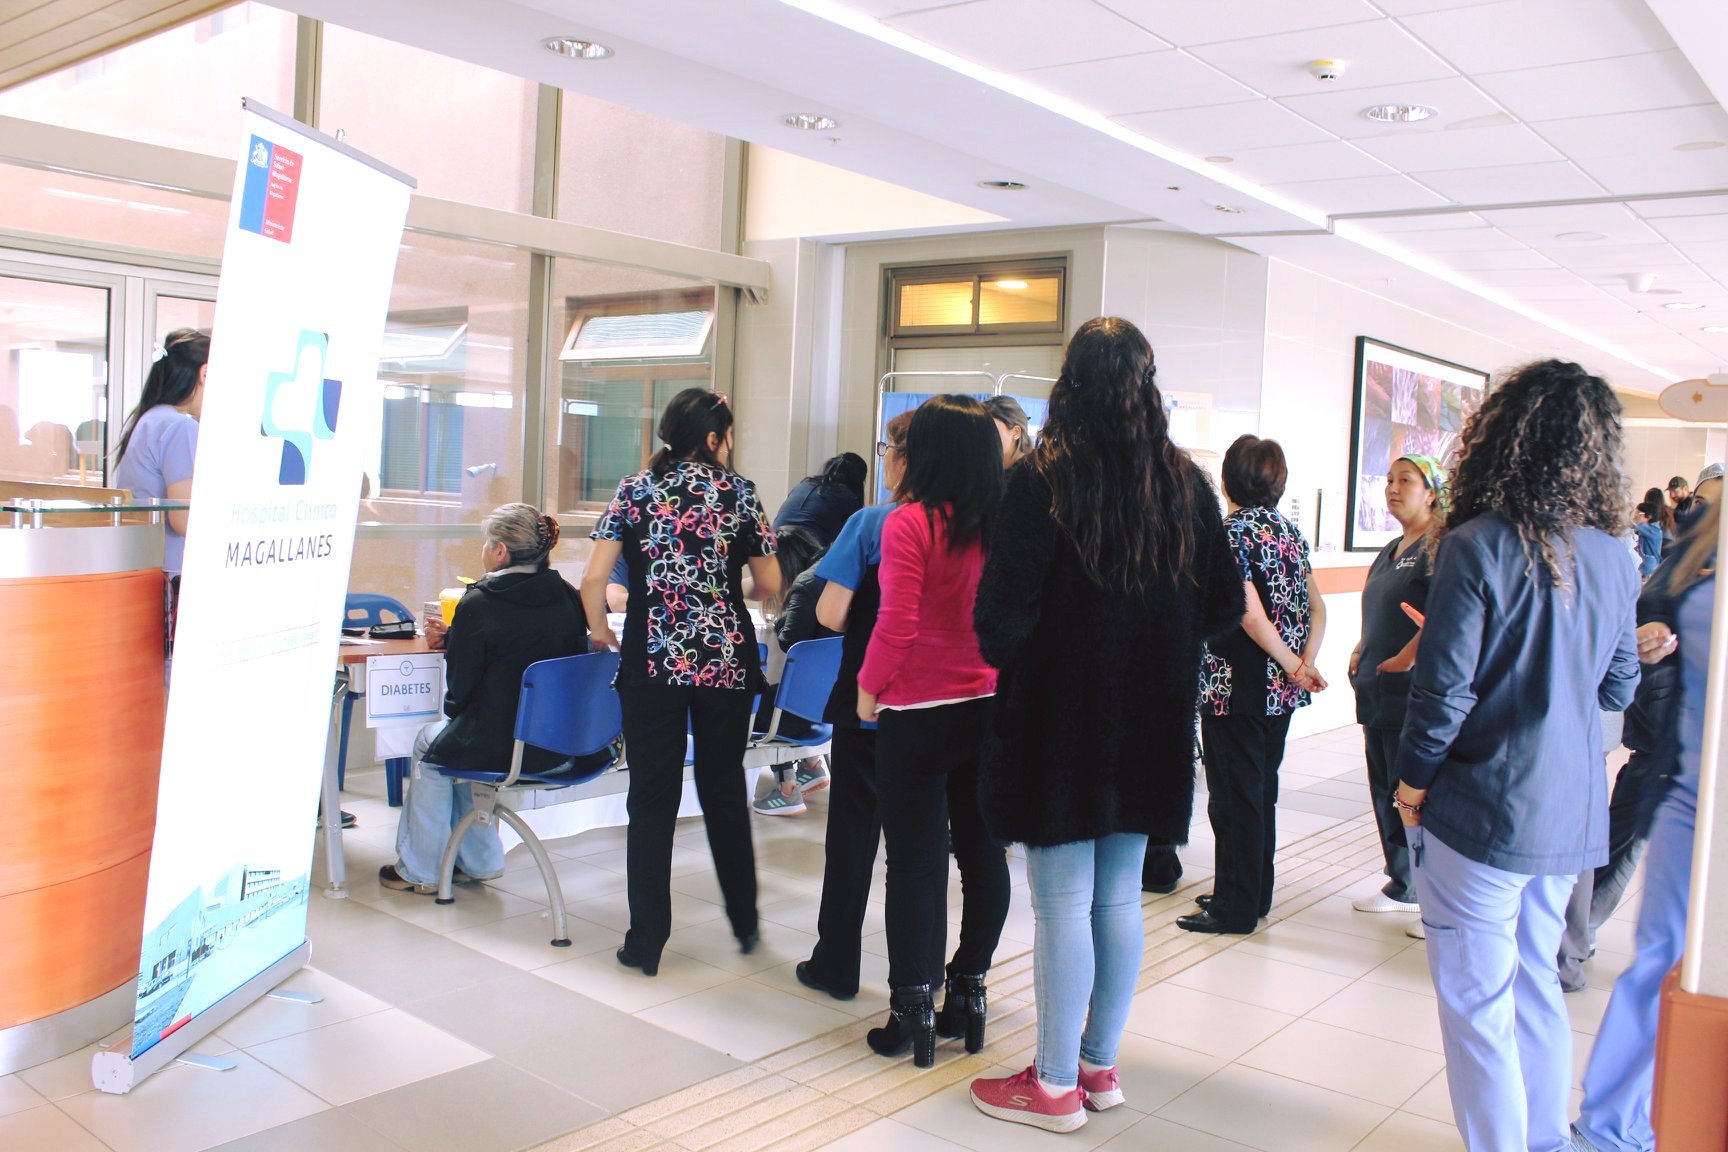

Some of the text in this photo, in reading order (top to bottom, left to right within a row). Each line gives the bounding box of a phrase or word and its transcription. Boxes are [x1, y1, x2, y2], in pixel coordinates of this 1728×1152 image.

[231, 499, 291, 528] Hospital
[225, 534, 333, 568] MAGALLANES
[381, 682, 431, 696] DIABETES
